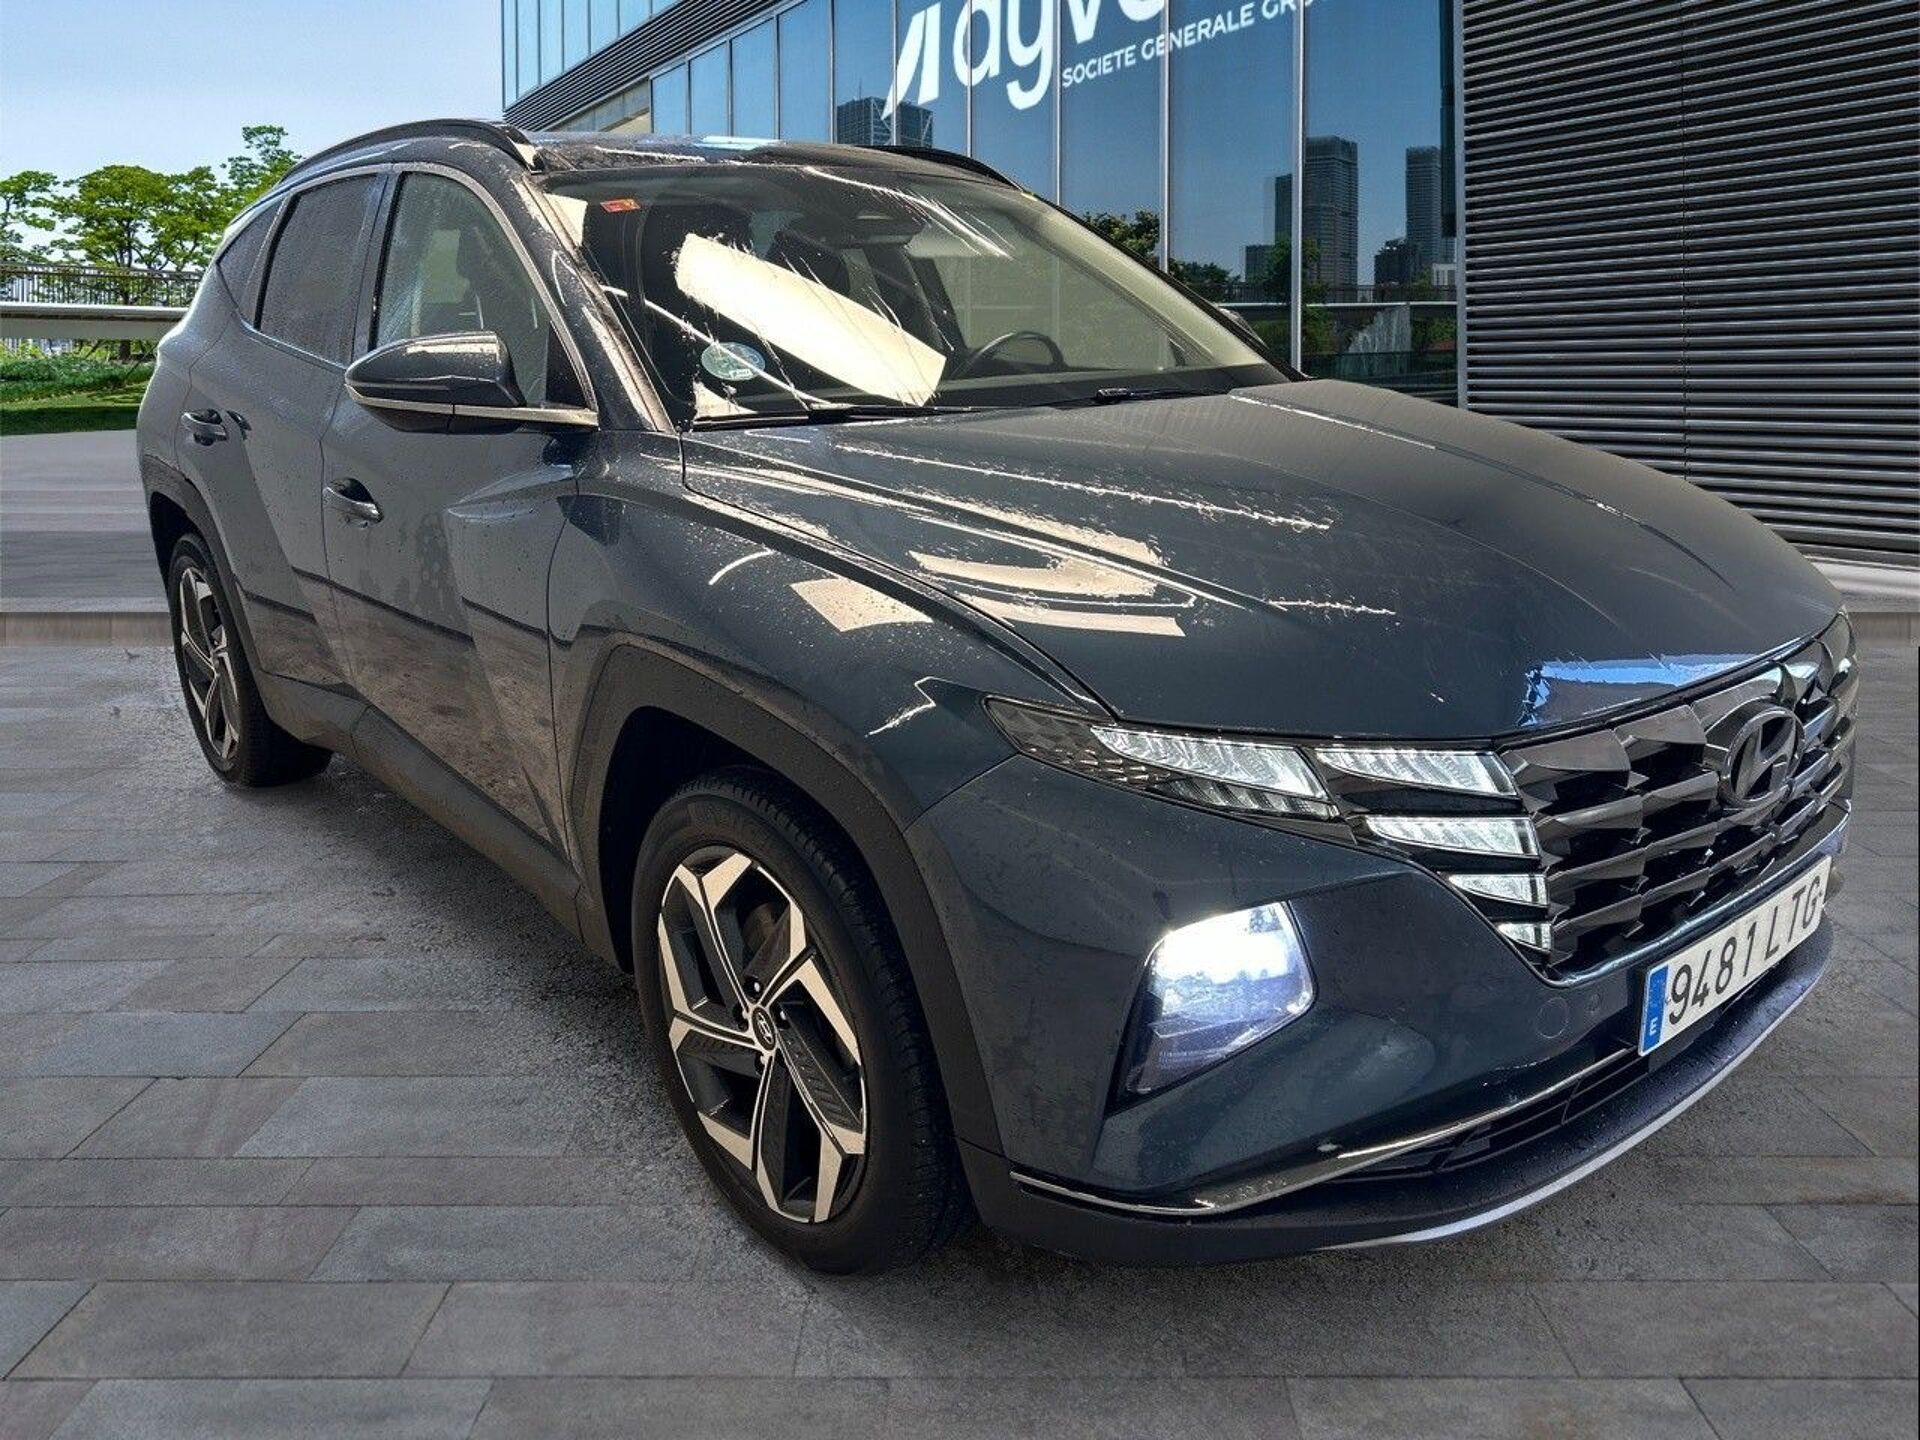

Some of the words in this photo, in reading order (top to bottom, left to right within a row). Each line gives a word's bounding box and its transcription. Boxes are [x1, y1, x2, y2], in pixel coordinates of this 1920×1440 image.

[953, 0, 1164, 110] ayv
[1062, 44, 1136, 88] SOCIETE
[1141, 2, 1255, 60] GENERALE
[1669, 921, 1757, 1025] 9481
[1765, 875, 1821, 960] LTG
[1649, 1017, 1658, 1033] E
